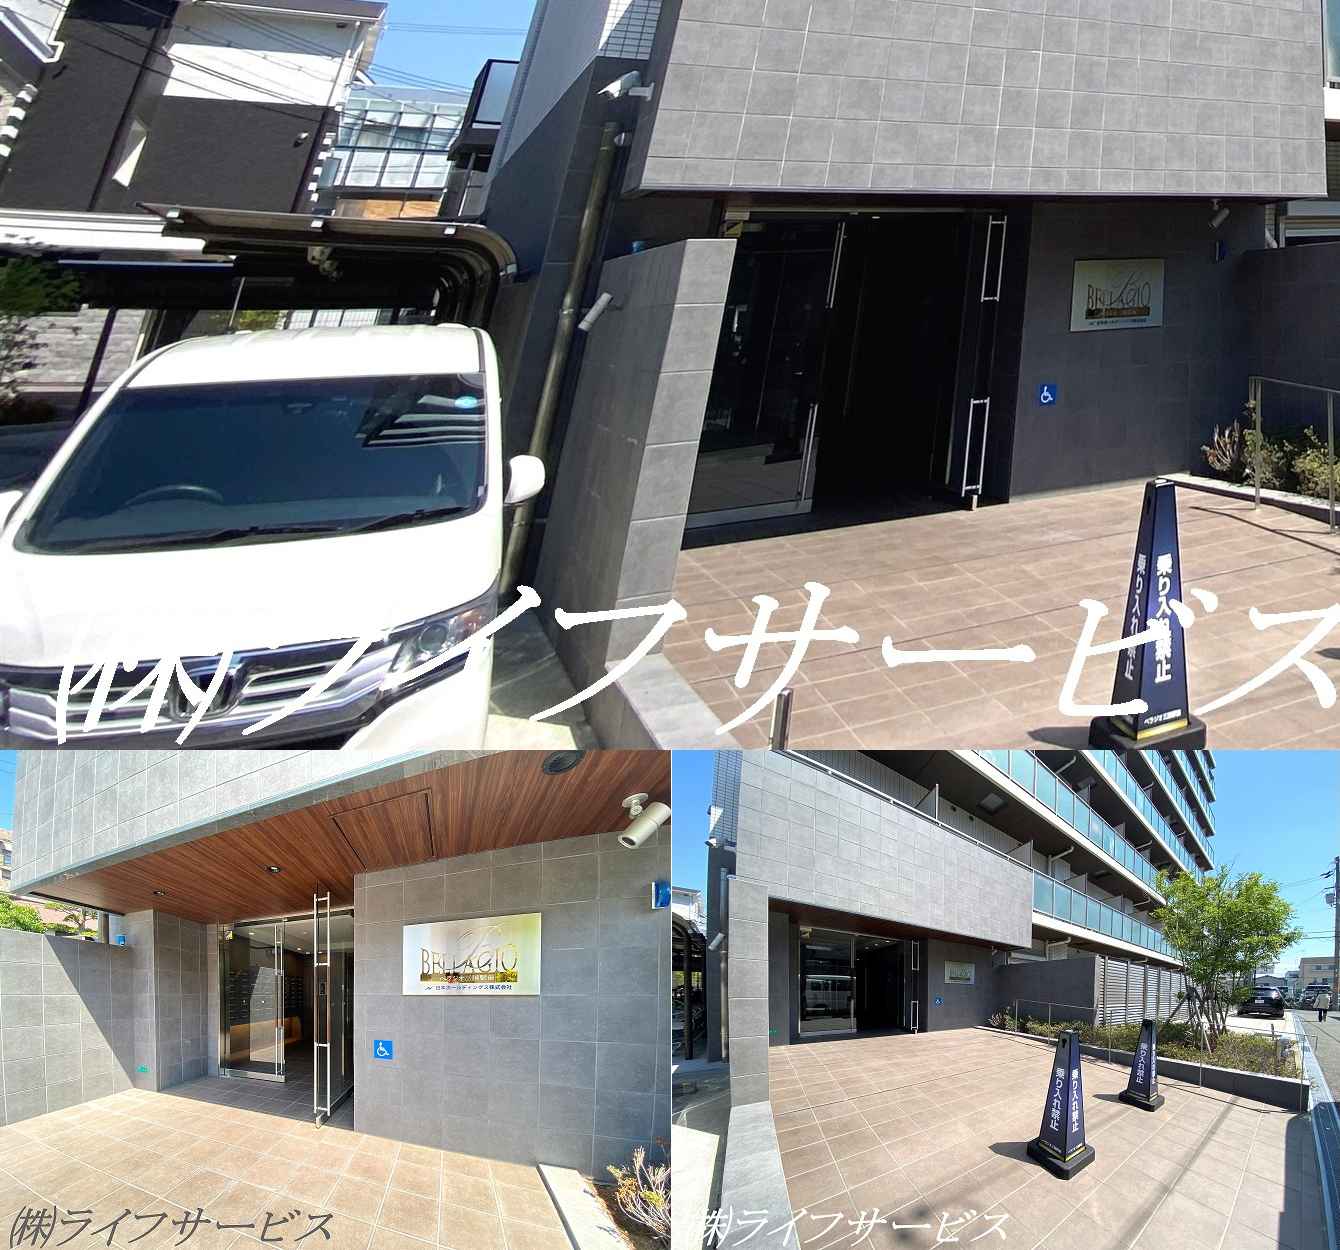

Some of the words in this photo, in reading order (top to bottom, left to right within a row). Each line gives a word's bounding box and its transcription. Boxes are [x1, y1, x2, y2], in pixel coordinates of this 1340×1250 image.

[420, 942, 519, 975] BELLAGIO
[1050, 1067, 1065, 1131] 乗り入れ禁止
[1071, 1068, 1079, 1133] 乗り入れ禁止
